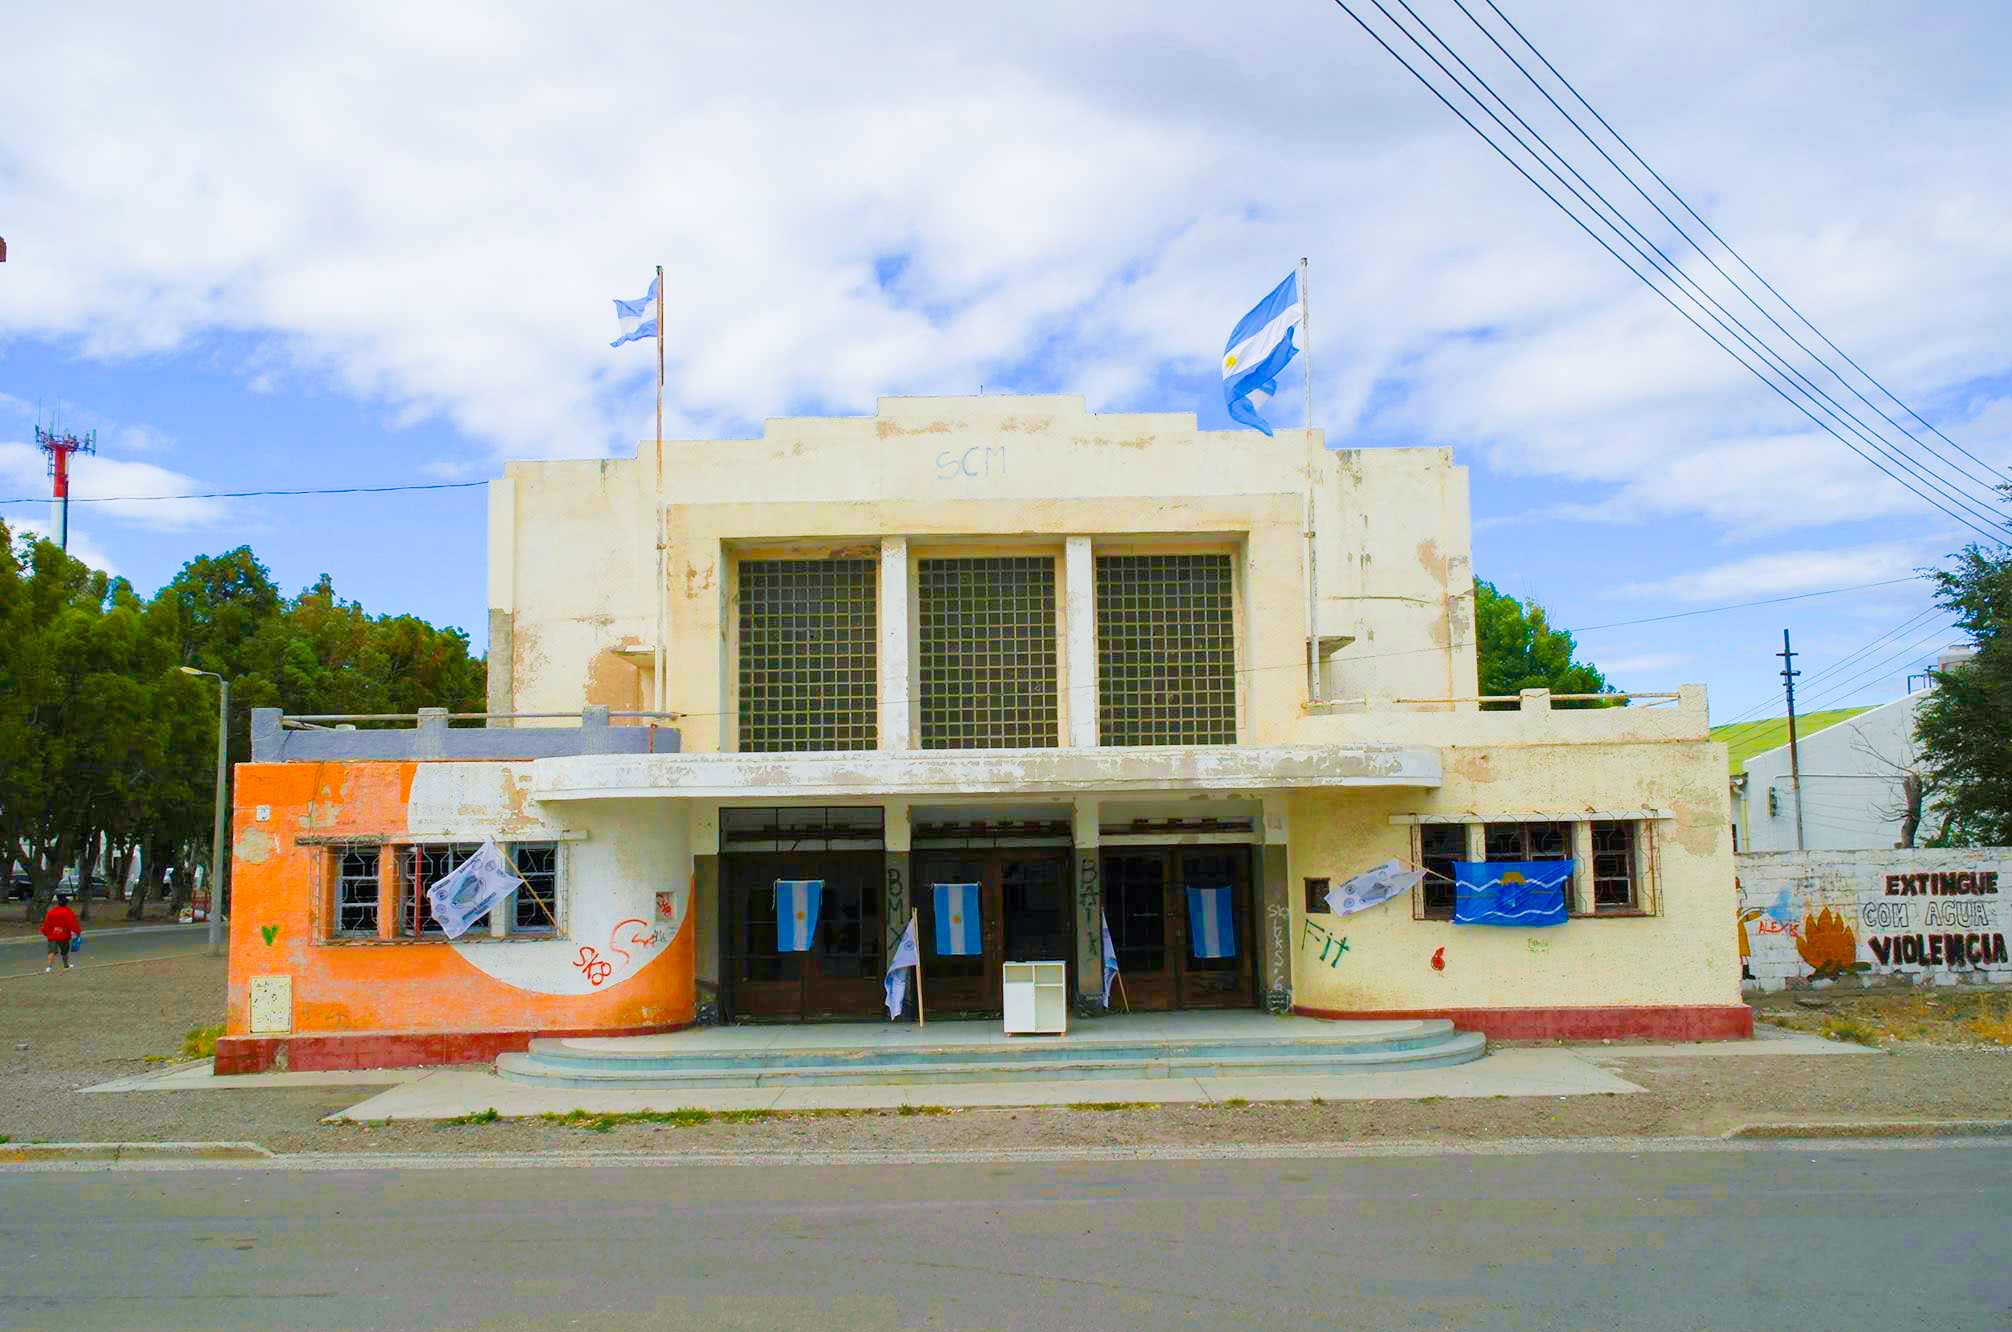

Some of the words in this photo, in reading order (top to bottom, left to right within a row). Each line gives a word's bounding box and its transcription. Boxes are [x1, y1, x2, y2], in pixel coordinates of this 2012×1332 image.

[935, 446, 1006, 480] SCM
[1885, 871, 1999, 896] EXTINGUE
[887, 868, 904, 950] BMX
[1863, 901, 1910, 928] CON
[1925, 901, 1989, 928] AGUA
[1868, 932, 2009, 967] VIOLENCIA
